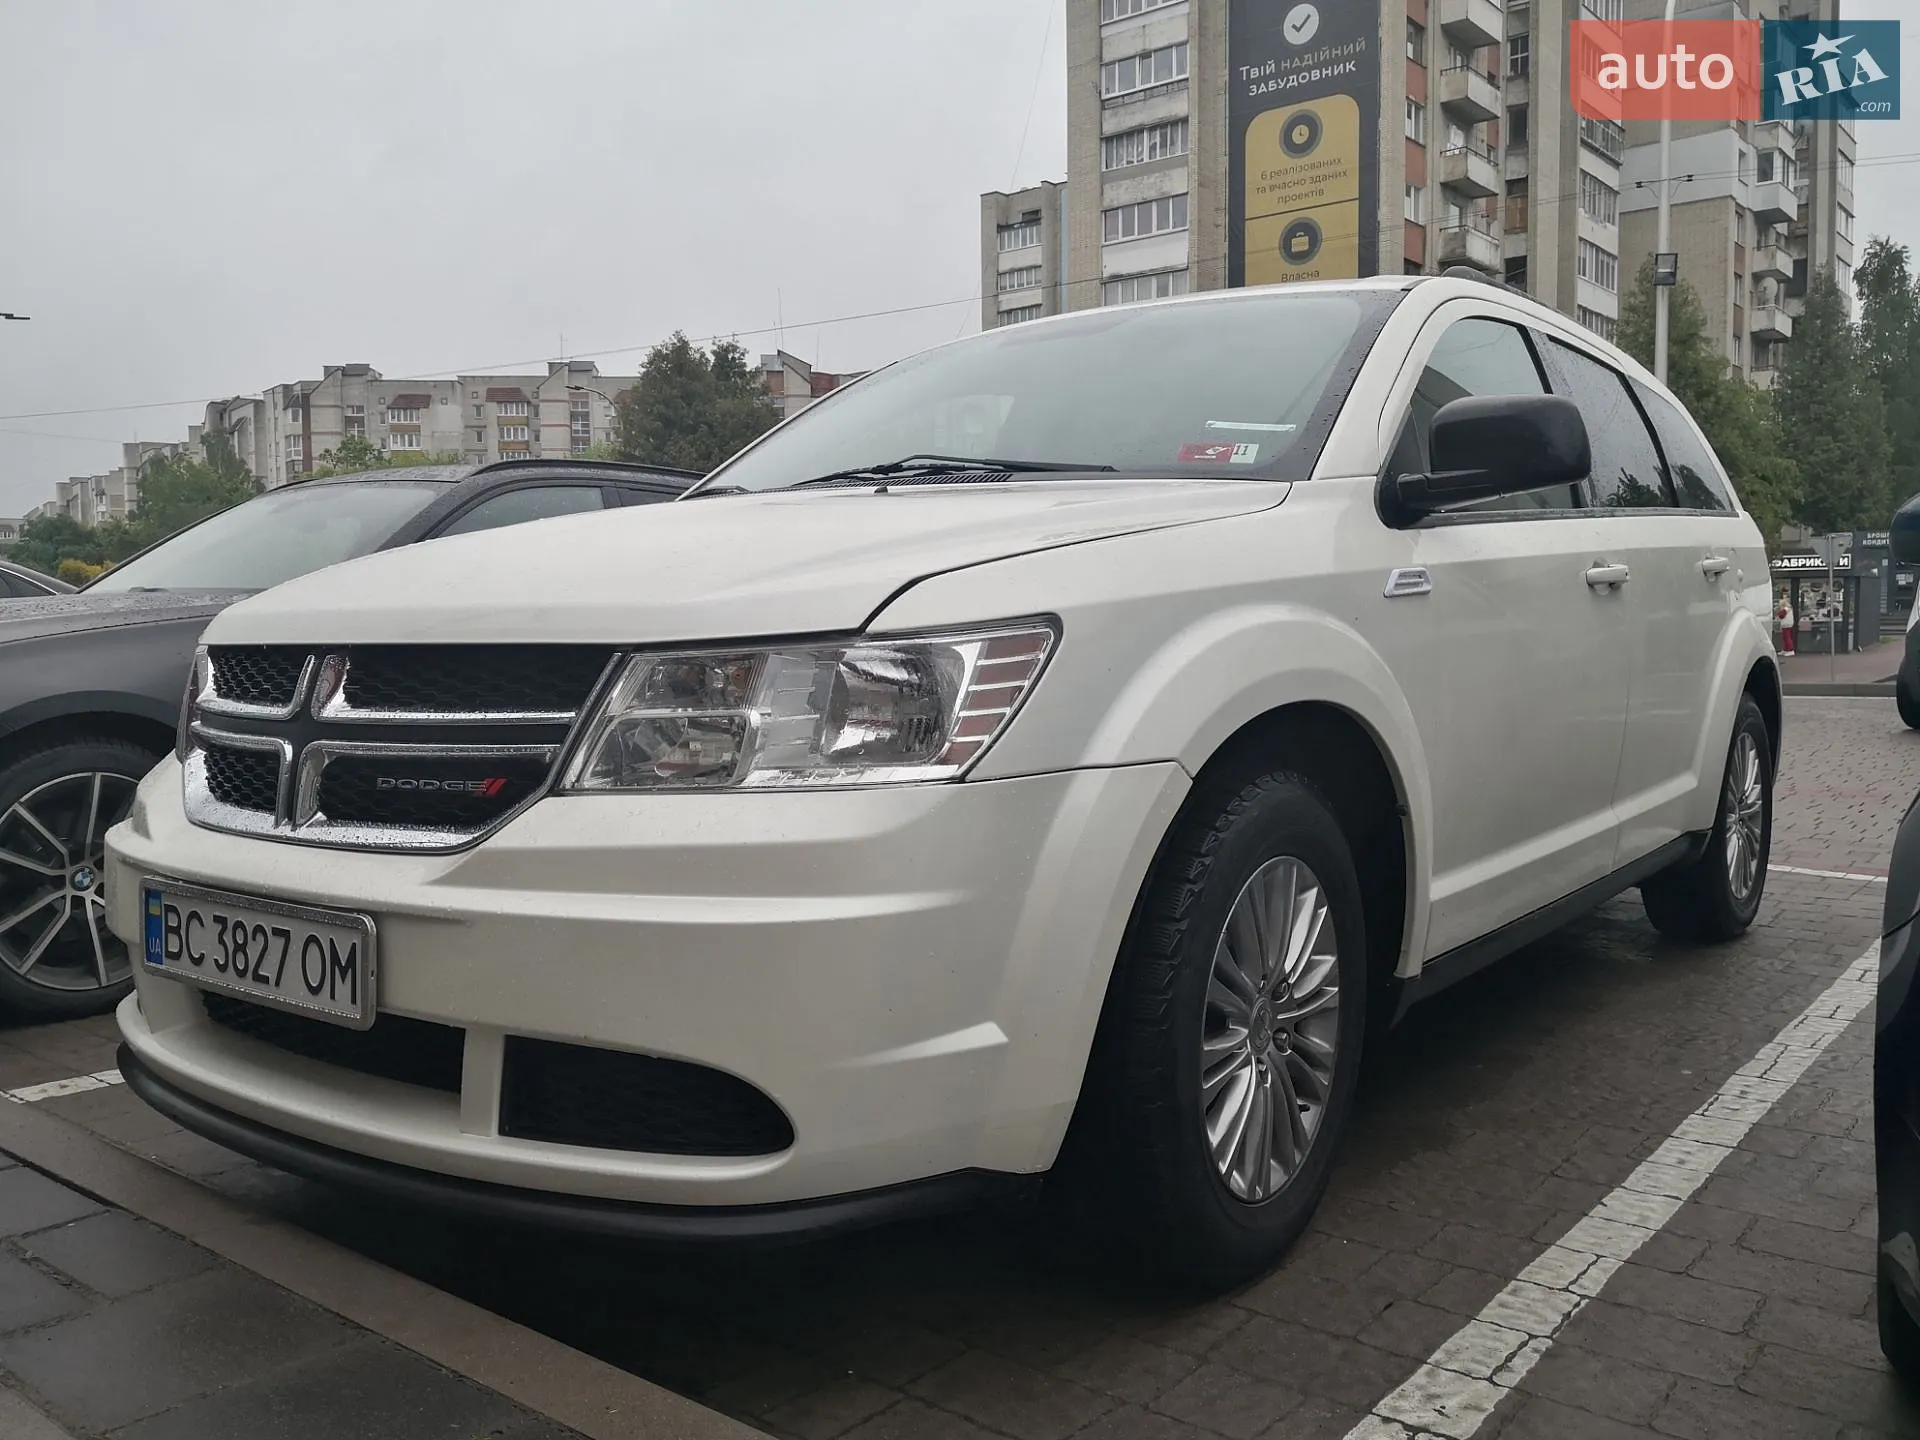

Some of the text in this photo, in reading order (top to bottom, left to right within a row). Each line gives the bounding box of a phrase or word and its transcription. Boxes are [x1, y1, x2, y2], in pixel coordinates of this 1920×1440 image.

[1281, 37, 1367, 71] НАДІЙНИЙ
[1249, 60, 1357, 96] ЗАБУДОВНИК
[1261, 158, 1343, 181] 6 реалізованих
[1256, 169, 1348, 195] та вчасно зданих
[1281, 270, 1320, 283] Власна
[376, 777, 487, 792] DODGE
[149, 937, 162, 955] UA
